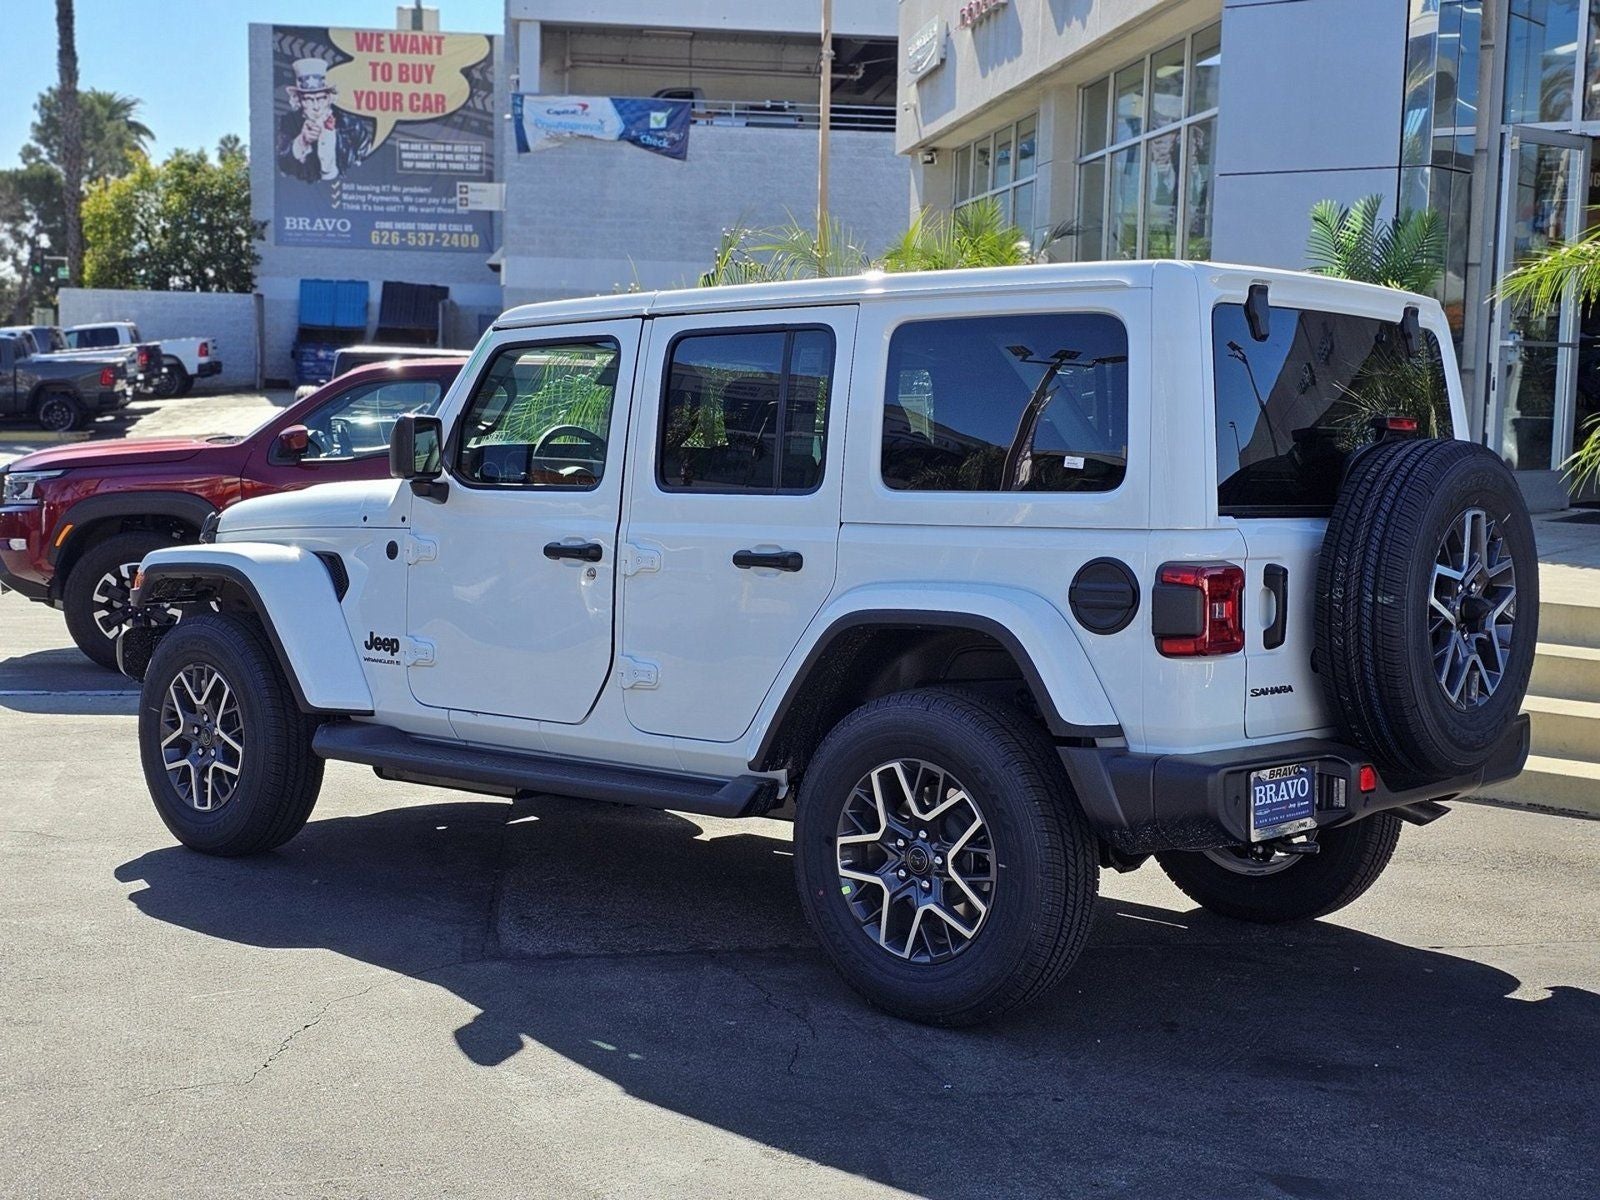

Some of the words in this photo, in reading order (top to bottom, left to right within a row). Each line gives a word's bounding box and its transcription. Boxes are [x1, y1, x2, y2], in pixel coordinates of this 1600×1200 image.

[354, 32, 384, 53] WE
[388, 33, 445, 56] WANT
[368, 61, 392, 82] TO
[398, 62, 436, 84] BUY
[353, 90, 404, 112] YOUR
[408, 92, 446, 114] CAR
[392, 184, 401, 192] No
[342, 193, 366, 202] Making
[403, 195, 413, 203] We
[428, 197, 439, 205] pay
[284, 216, 351, 232] BRAVO
[395, 222, 416, 230] INSIDE
[417, 222, 437, 231] TODAY
[438, 223, 447, 231] OR
[449, 223, 463, 231] CALL
[465, 224, 473, 232] US
[370, 230, 480, 248] 626-537-2400
[364, 631, 400, 656] Jeep
[363, 656, 395, 664] WRANGLER
[1250, 684, 1294, 697] SAHARA
[1268, 765, 1300, 779] BRAVO
[1254, 777, 1308, 806] BRAVO
